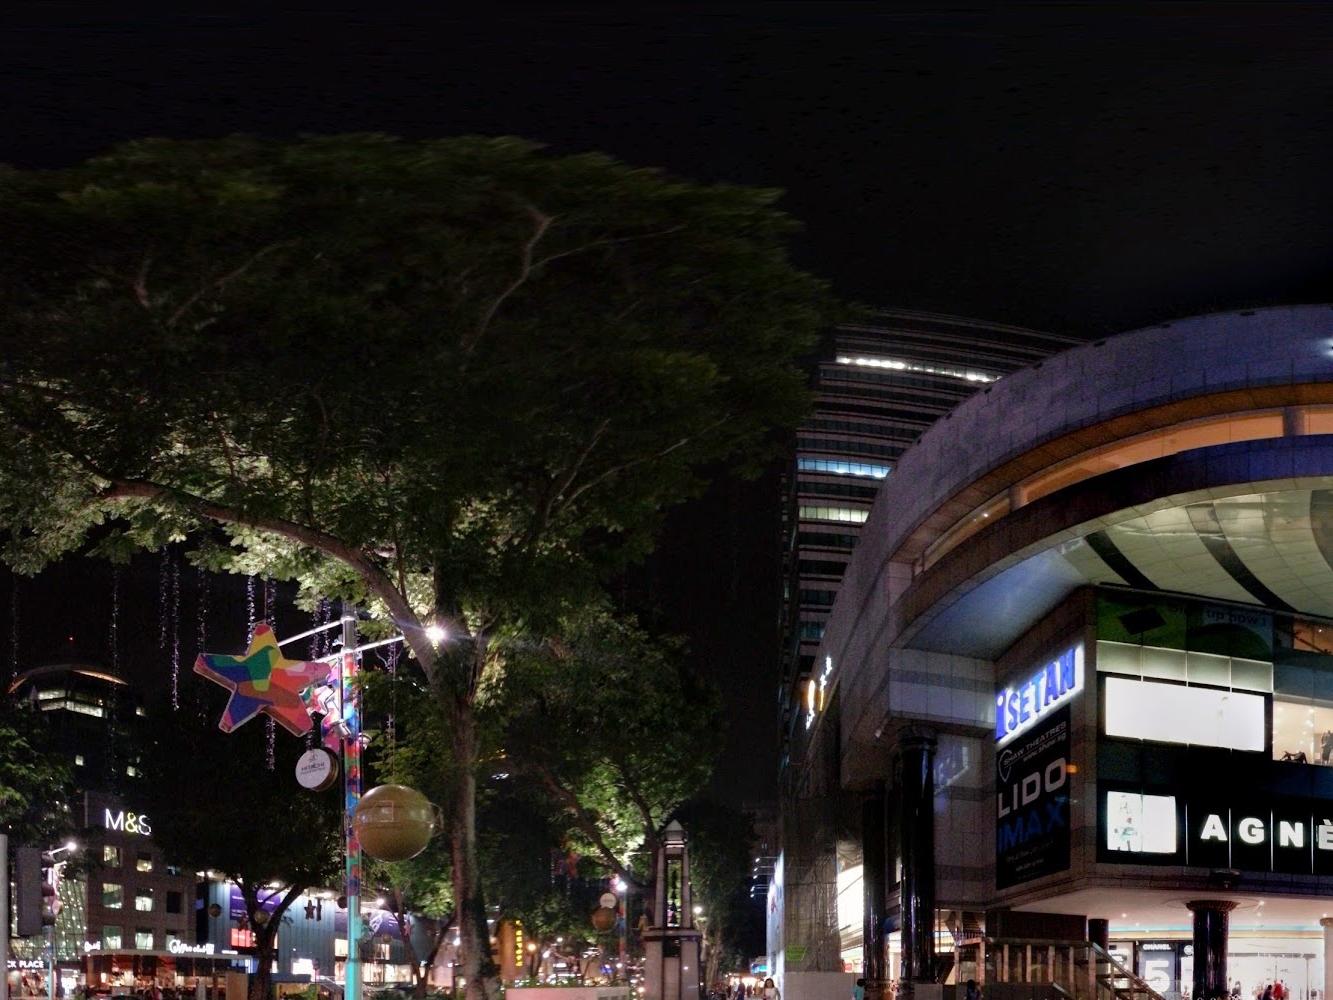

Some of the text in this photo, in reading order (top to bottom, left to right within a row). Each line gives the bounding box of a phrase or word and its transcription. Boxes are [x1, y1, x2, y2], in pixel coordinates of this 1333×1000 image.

[1026, 721, 1067, 751] THEATRES
[998, 757, 1066, 819] LIDO
[105, 808, 152, 836] M&S
[998, 799, 1067, 855] IMAX
[1142, 943, 1171, 951] CHANEL
[18, 960, 44, 969] PLACE
